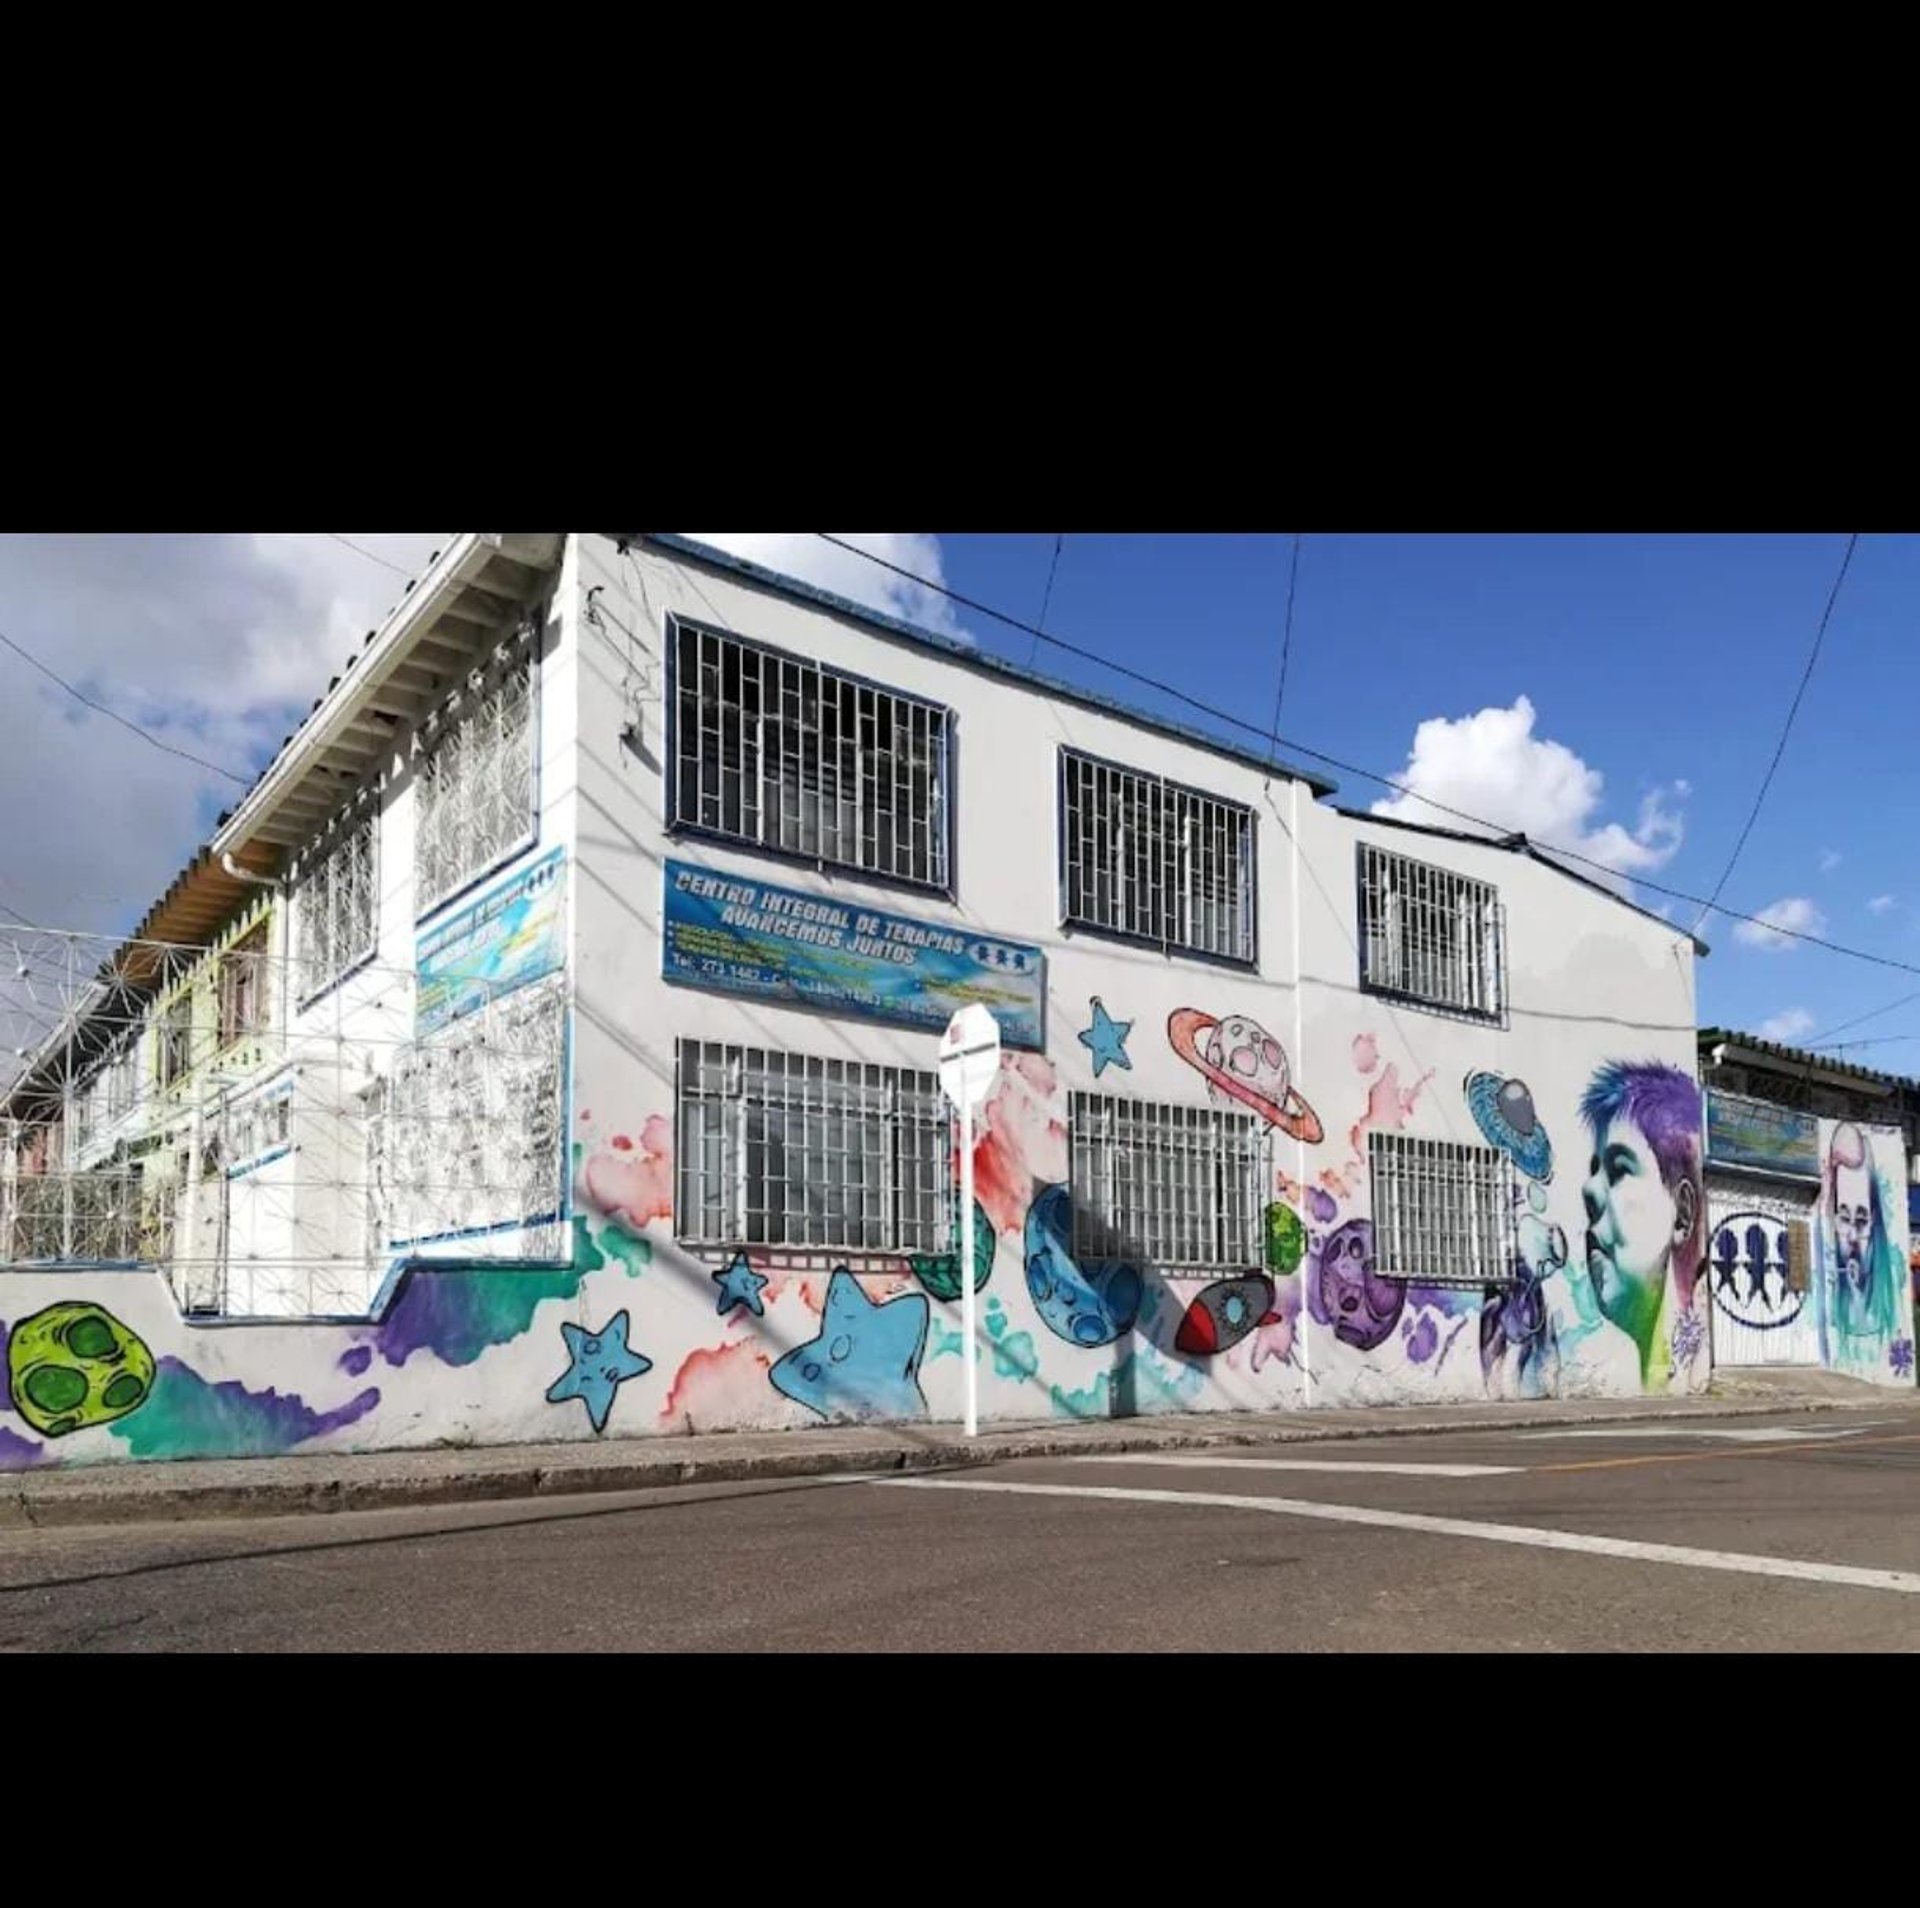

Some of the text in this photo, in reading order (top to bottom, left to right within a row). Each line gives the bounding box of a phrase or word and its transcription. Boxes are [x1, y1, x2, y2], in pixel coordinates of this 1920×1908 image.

[675, 870, 966, 956] CENTRO INTEGRAL DE TERAPIAS
[721, 906, 843, 947] AVANCEMOS
[846, 935, 918, 965] JUNTOS
